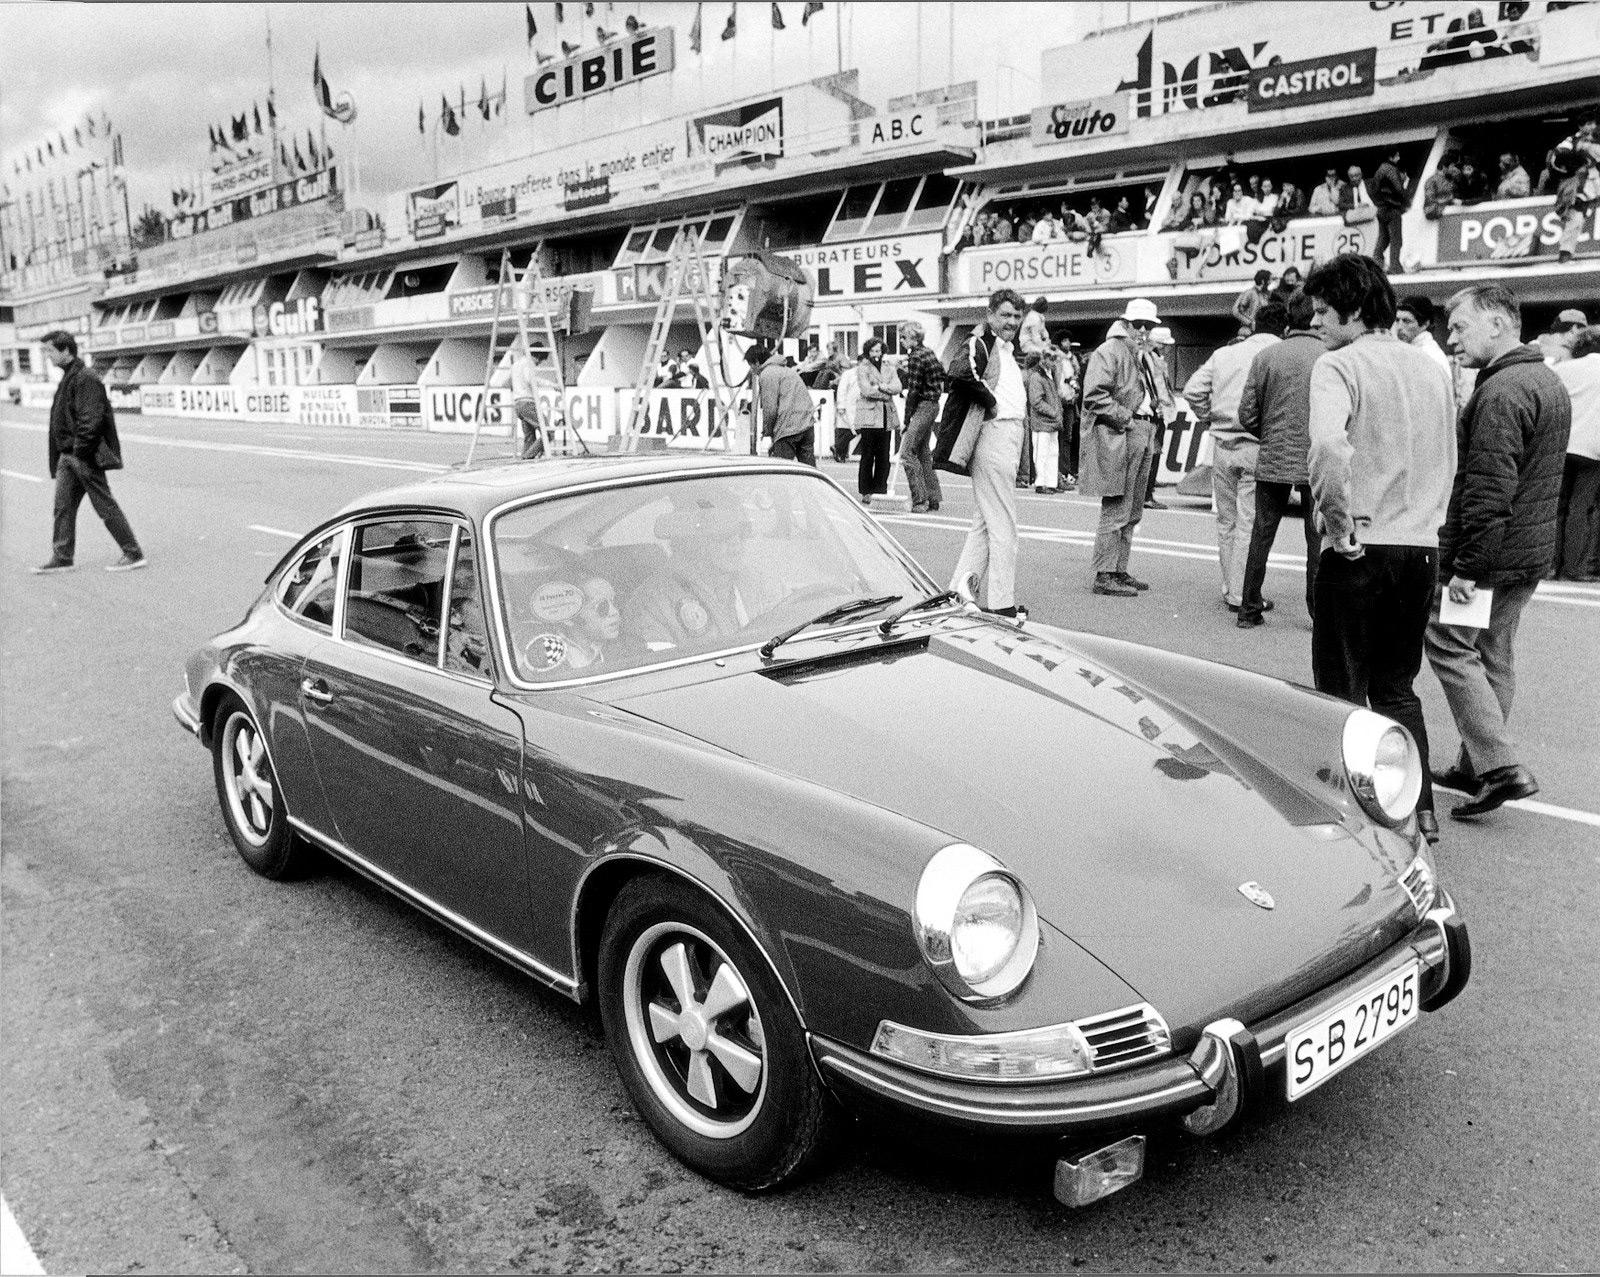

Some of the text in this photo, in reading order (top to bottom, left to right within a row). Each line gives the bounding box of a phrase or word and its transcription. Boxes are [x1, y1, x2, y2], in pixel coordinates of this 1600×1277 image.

[1390, 13, 1444, 40] ET
[535, 36, 656, 104] CIBIE
[1258, 62, 1362, 99] CASTROL
[708, 122, 776, 154] CHAMPION
[871, 113, 924, 144] A.B.C
[1054, 110, 1116, 139] auto
[641, 144, 676, 169] entier
[983, 253, 1081, 282] PORSCHE
[269, 296, 319, 336] Gulf
[181, 389, 239, 414] BARDAHL
[432, 392, 501, 424] LUCAS
[1353, 973, 1414, 1050] 2795
